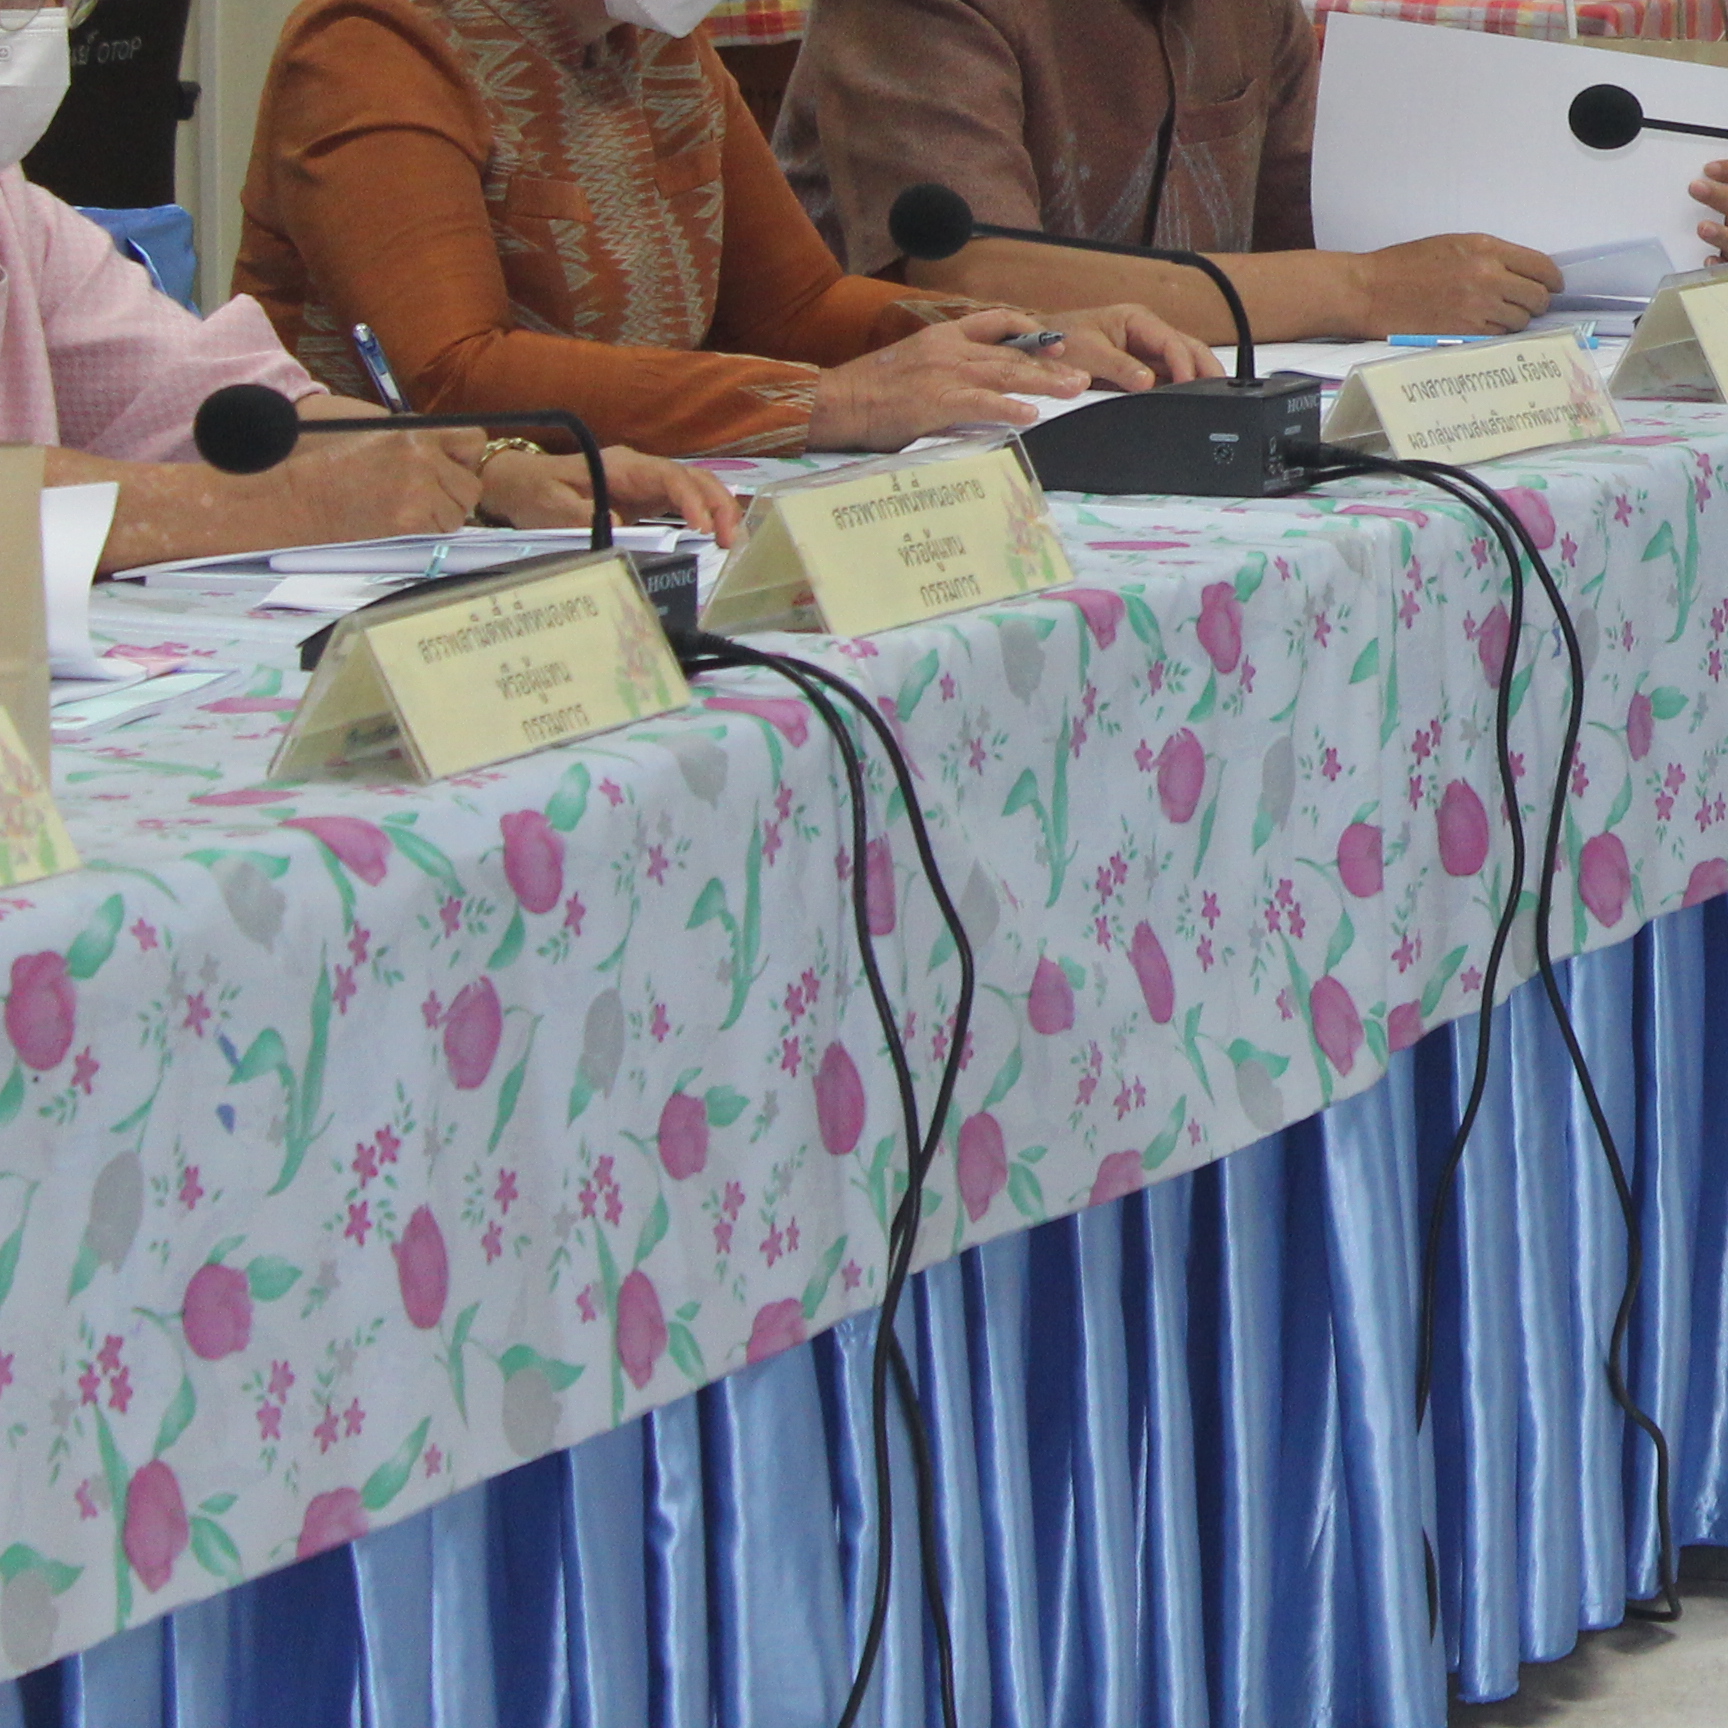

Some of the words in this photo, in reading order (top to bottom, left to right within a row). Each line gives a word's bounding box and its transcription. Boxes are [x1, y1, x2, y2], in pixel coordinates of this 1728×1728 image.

[920, 574, 982, 608] กรรมการ
[521, 703, 592, 745] กรรมการ
